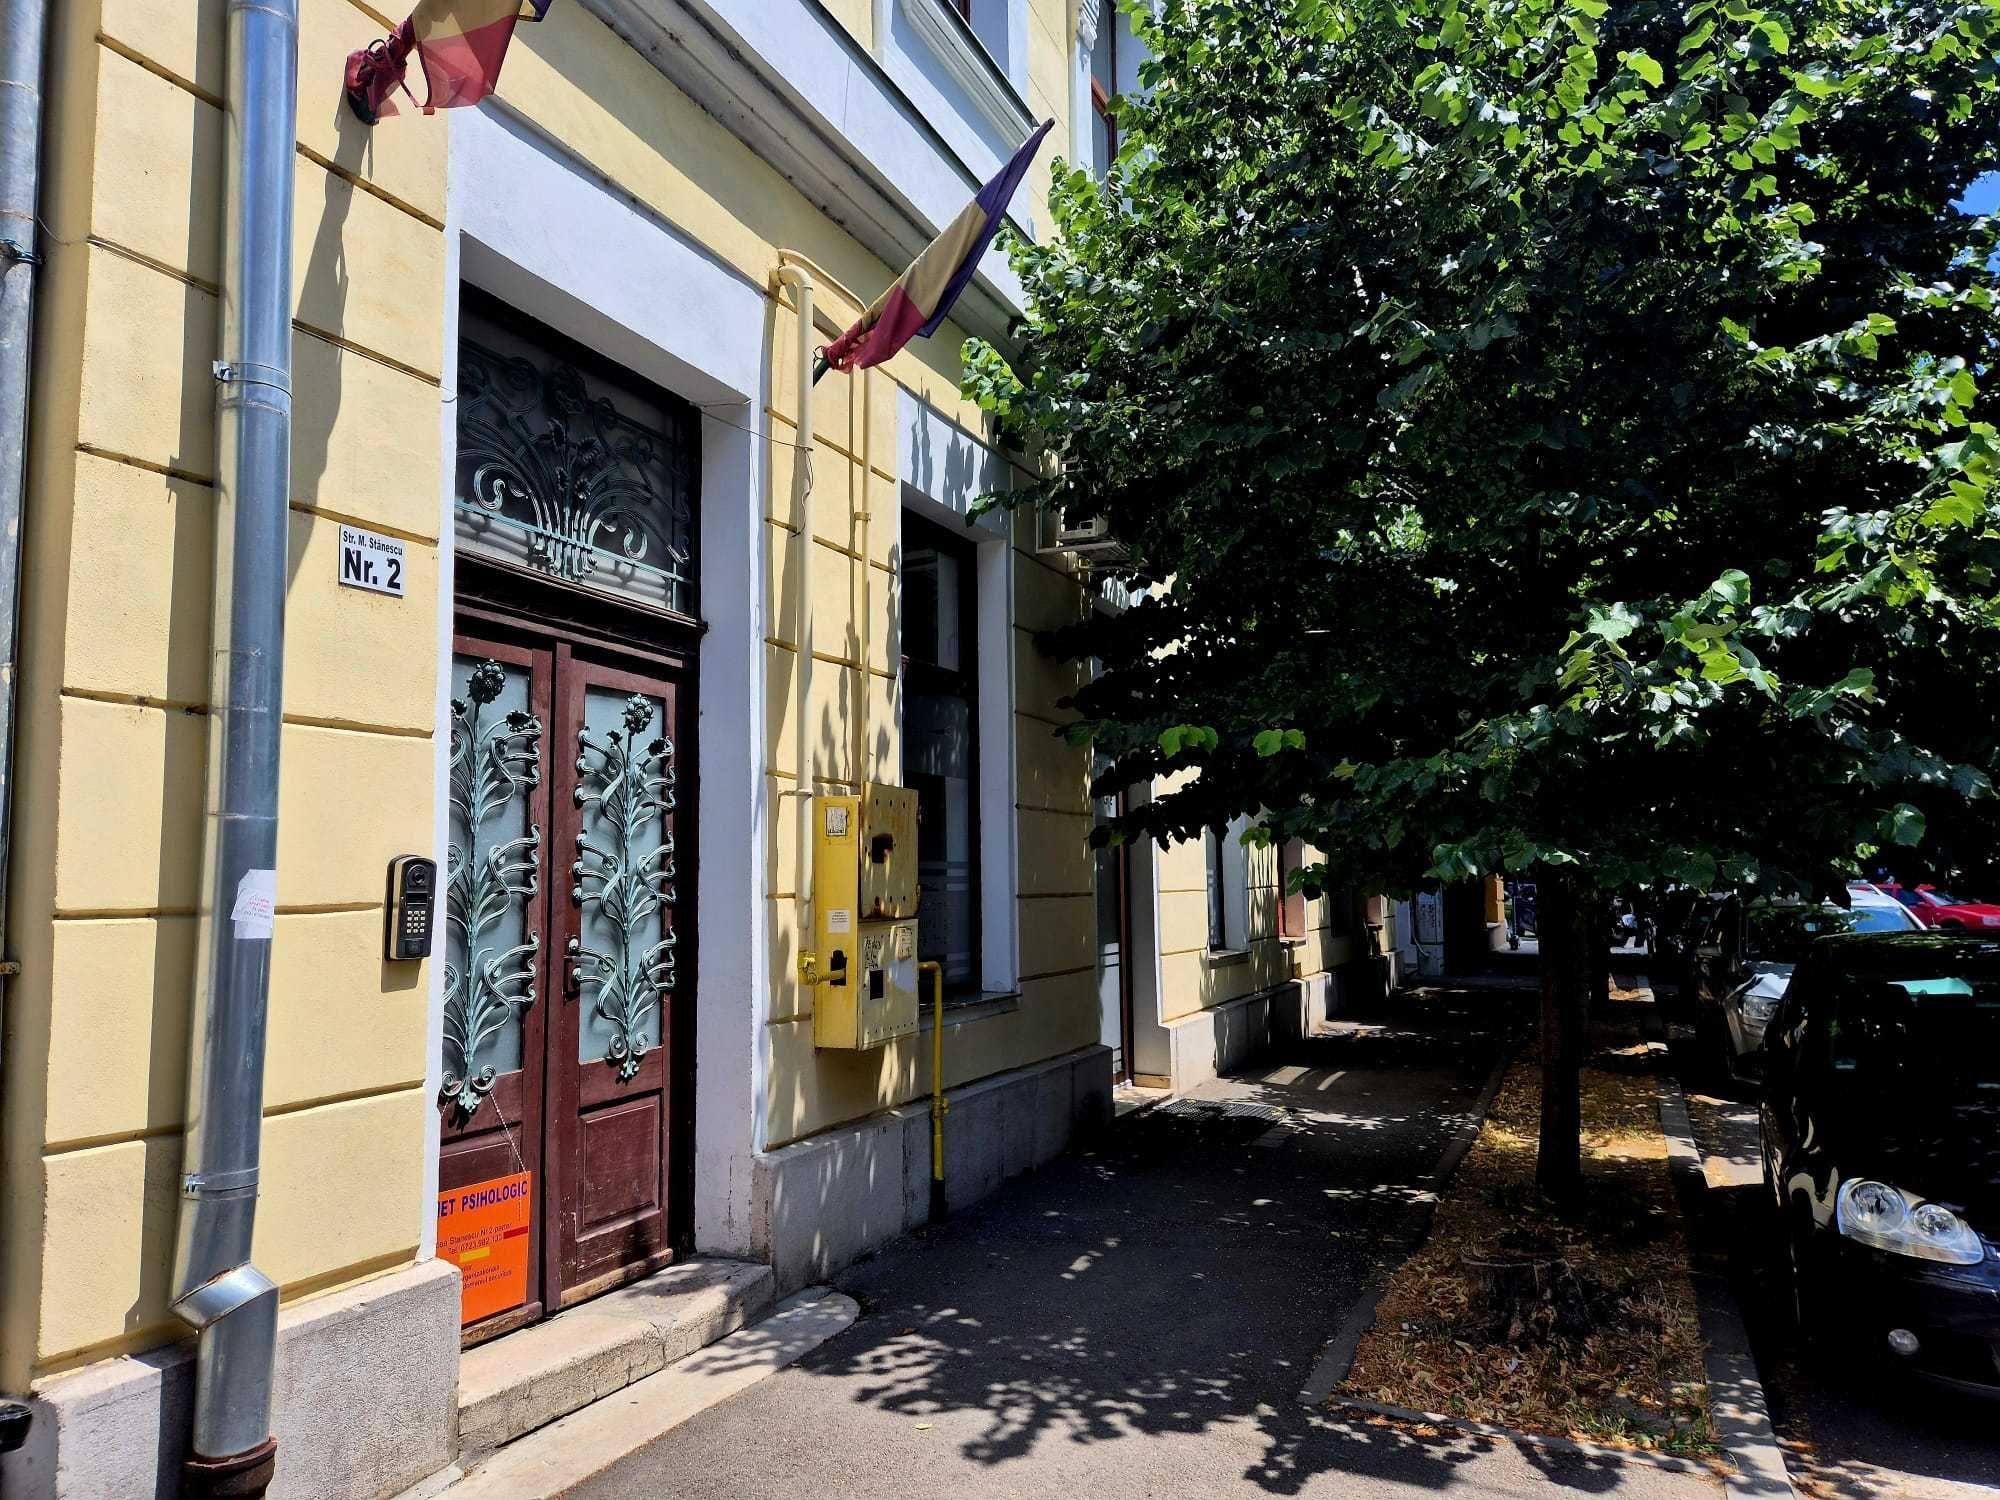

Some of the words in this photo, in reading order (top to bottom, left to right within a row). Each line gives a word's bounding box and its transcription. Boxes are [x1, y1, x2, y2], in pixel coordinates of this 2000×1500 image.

[343, 530, 356, 545] Str.
[359, 534, 367, 547] M.
[344, 547, 378, 585] Nr.
[387, 558, 401, 590] 2
[462, 1180, 528, 1212] PSIHOLOGIC
